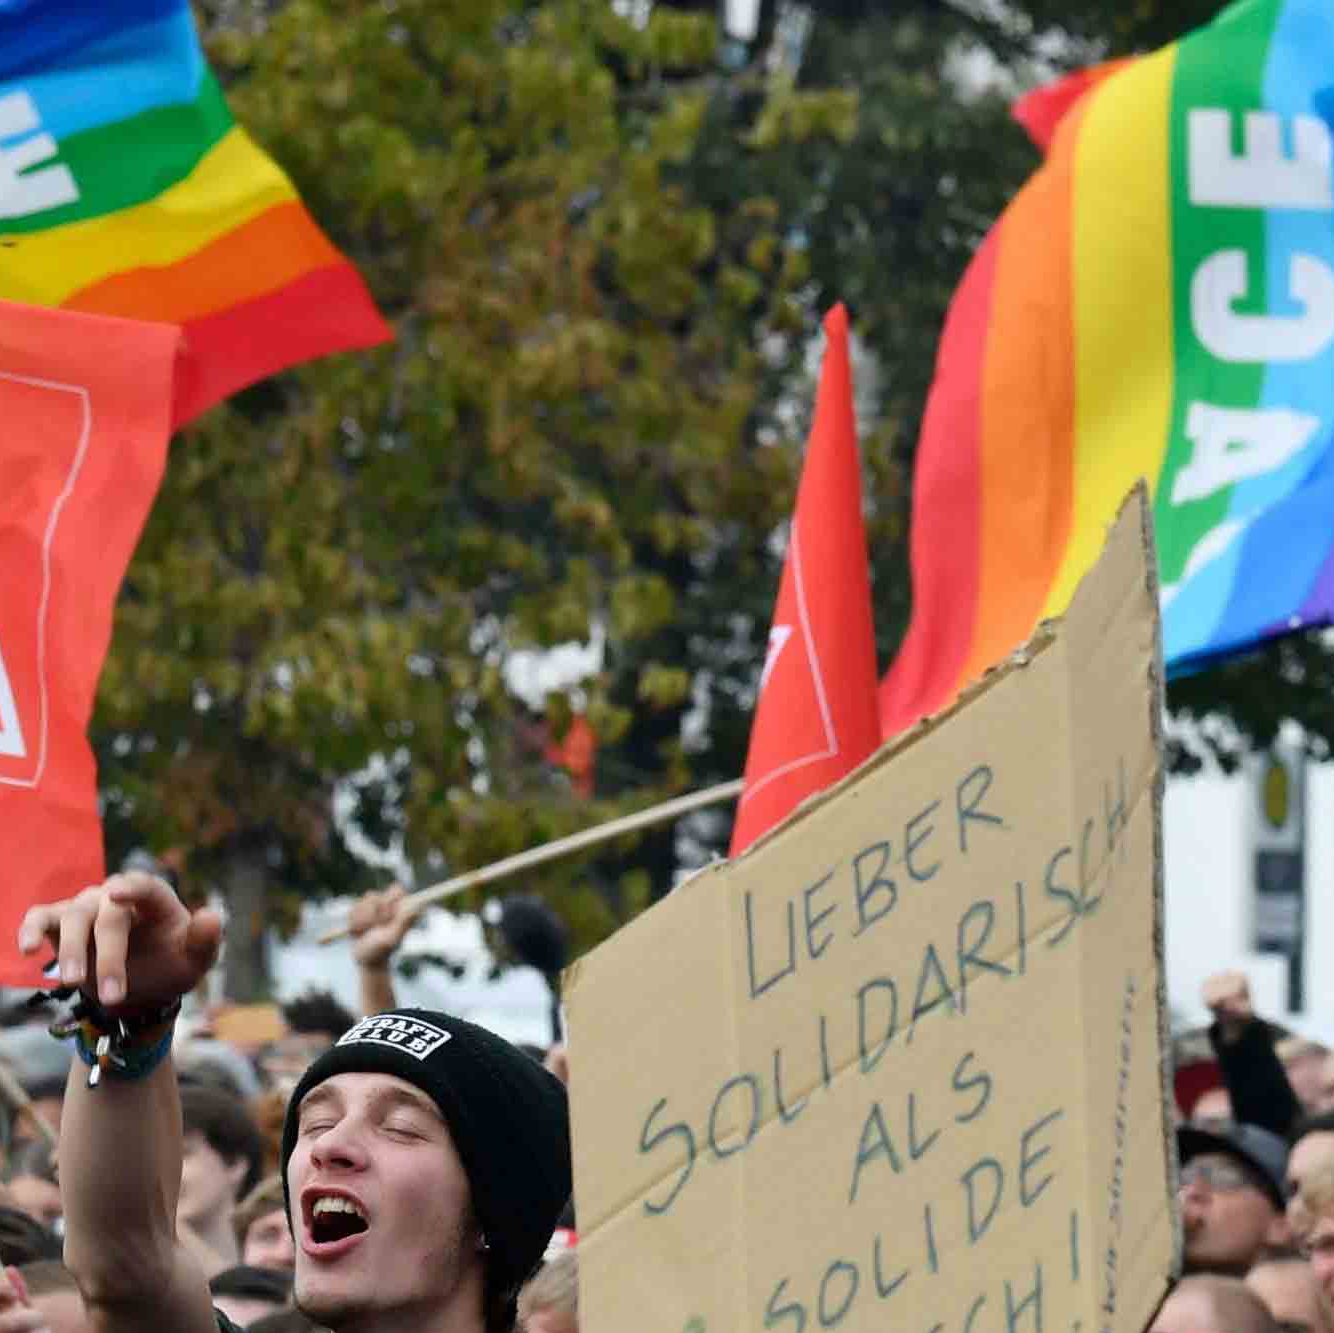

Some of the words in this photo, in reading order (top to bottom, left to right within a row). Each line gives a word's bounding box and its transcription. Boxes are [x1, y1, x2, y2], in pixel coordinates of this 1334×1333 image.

[638, 757, 1129, 1216] SOLIDARISCH
[743, 764, 1005, 999] LIEBER
[848, 1050, 992, 1204] ALS
